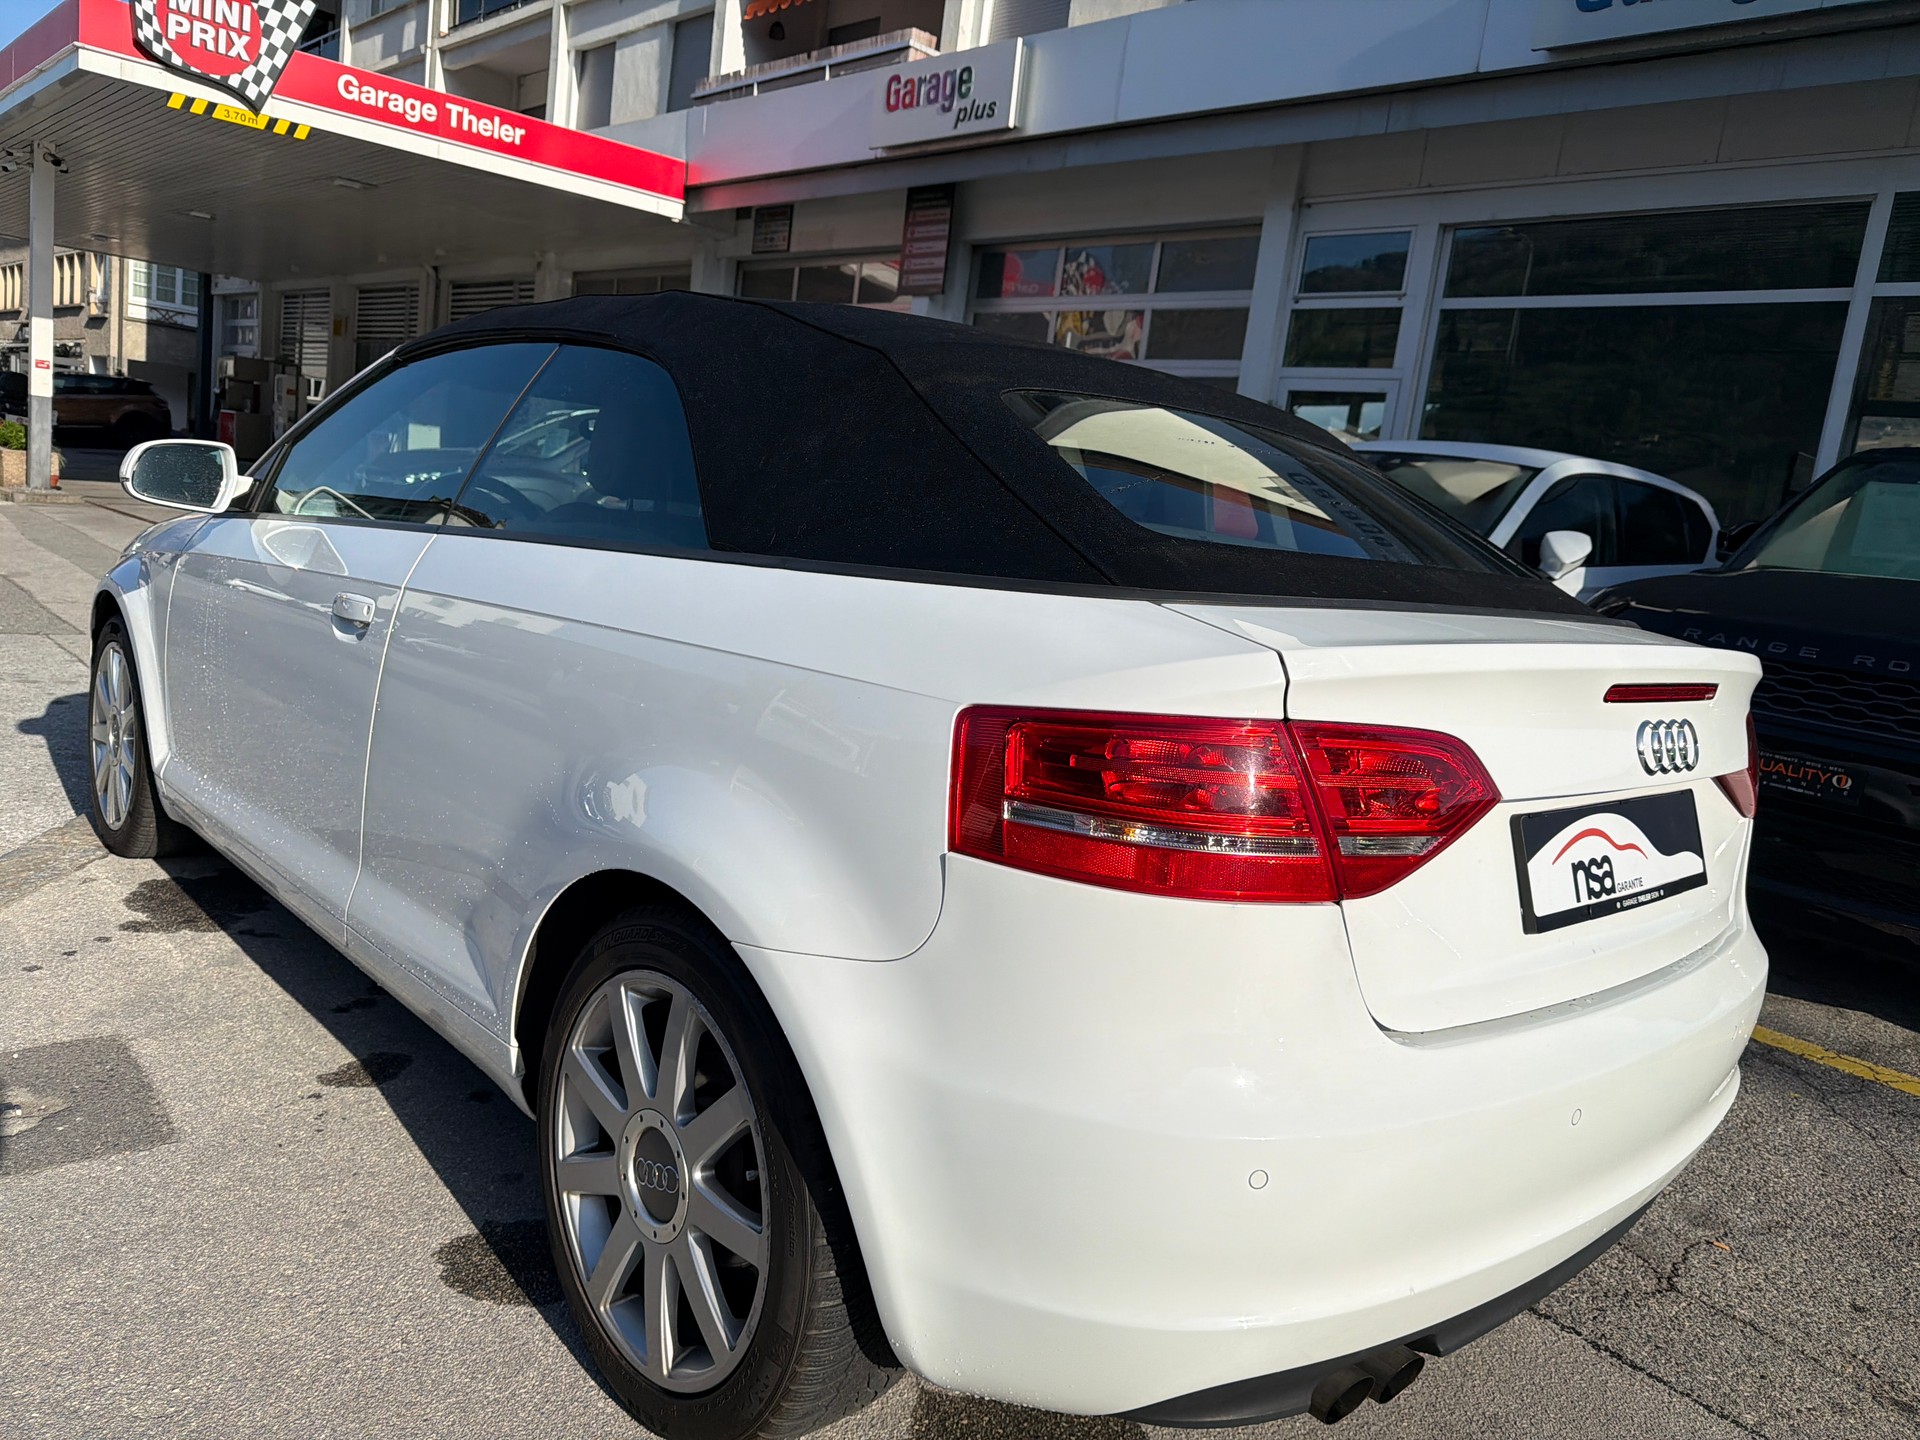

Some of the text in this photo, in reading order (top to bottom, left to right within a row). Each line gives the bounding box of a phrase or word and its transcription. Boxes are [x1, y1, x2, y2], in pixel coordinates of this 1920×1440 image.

[167, 12, 251, 62] PRIX
[886, 66, 973, 113] Garage
[223, 108, 247, 123] 3.70
[337, 74, 526, 146] Garage Theler
[953, 98, 997, 130] plus
[1682, 626, 1821, 660] RANGE
[1760, 758, 1832, 784] UALITY
[1571, 855, 1644, 904] nsa GARANTIE
